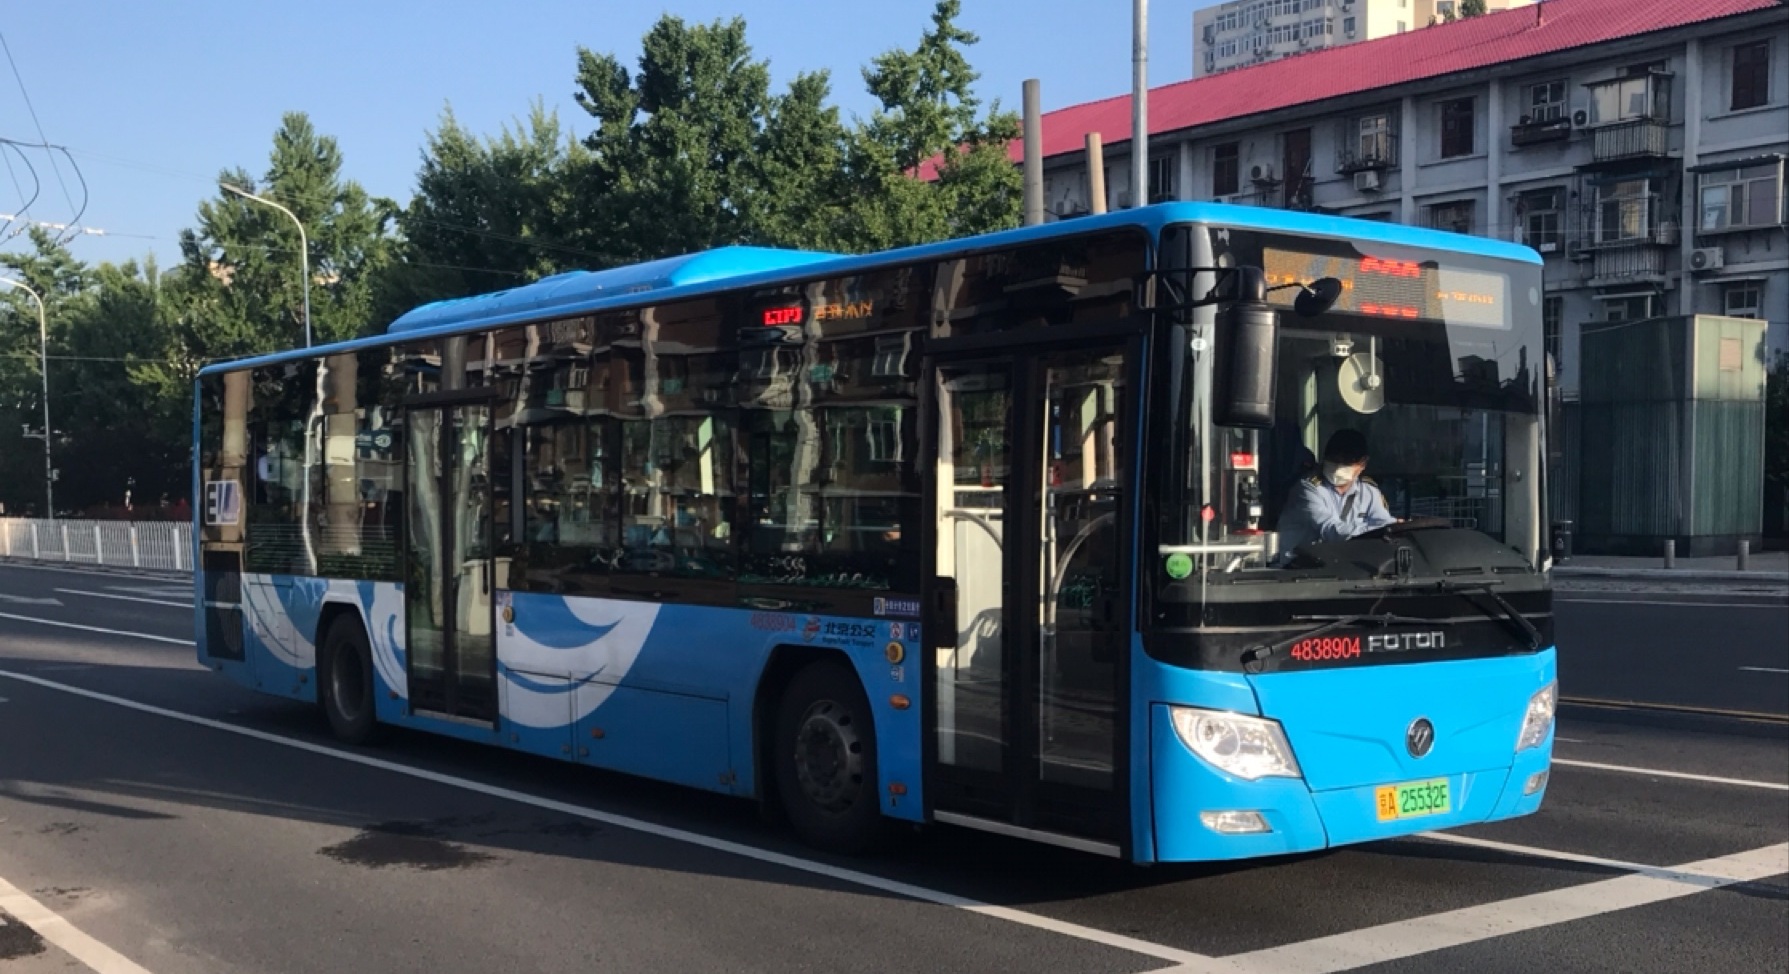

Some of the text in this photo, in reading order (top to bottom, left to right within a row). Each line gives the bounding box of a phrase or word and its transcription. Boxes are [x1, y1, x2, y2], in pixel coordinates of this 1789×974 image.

[824, 622, 875, 638] 北京公交
[1291, 637, 1361, 661] 4838904
[1368, 631, 1445, 652] FOTON
[1402, 785, 1447, 812] 25532F
